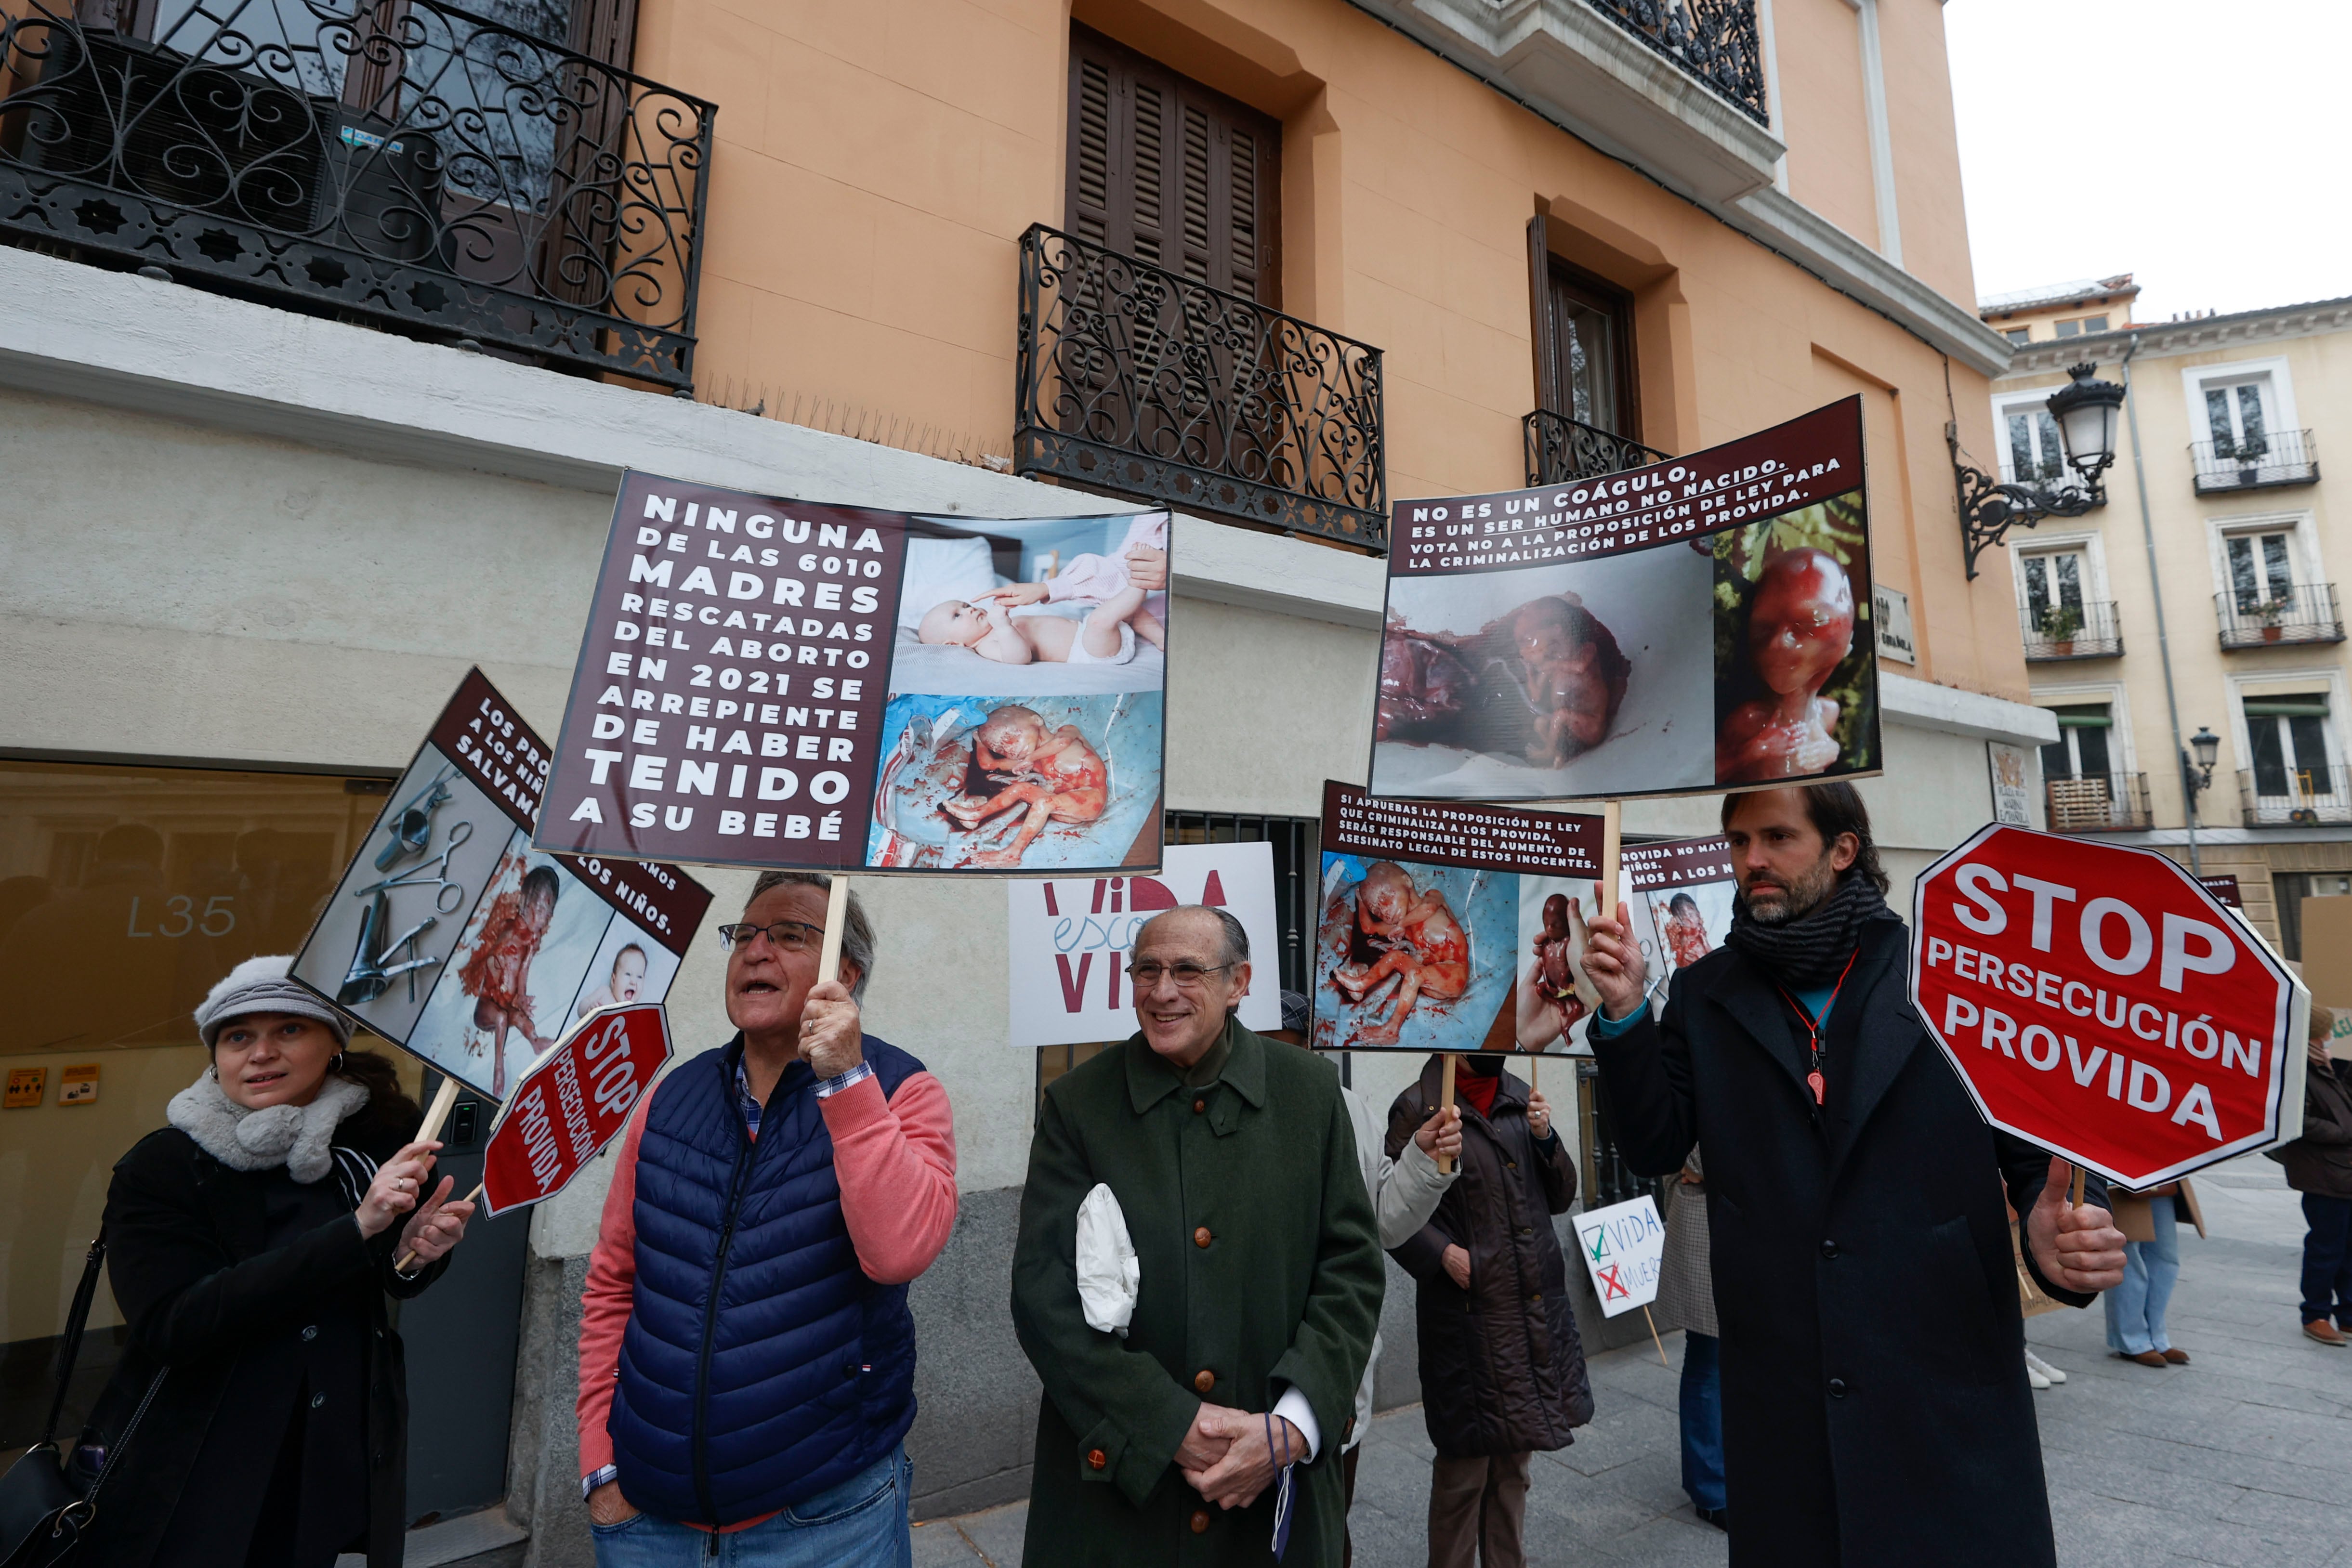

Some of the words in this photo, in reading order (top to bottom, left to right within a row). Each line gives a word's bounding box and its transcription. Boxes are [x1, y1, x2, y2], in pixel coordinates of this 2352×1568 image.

[1411, 543, 1459, 554] VOTA
[1468, 540, 1492, 551] NO
[1501, 538, 1513, 548] A
[1522, 534, 1545, 546] LA
[1554, 504, 1690, 541] PROPOSICIÓN
[1700, 494, 1726, 511] DE
[1736, 480, 1773, 501] LEY
[1783, 458, 1840, 486] PARA
[1412, 526, 1435, 538] ES
[1446, 524, 1473, 536] UN
[1485, 519, 1523, 533] SER
[1535, 499, 1629, 527] HUMANO
[1641, 490, 1672, 507] NO
[1683, 459, 1785, 497] NACIDO.
[1413, 507, 1448, 522] NO
[1462, 503, 1491, 519] ES
[1505, 497, 1539, 514] UN
[1553, 466, 1696, 508] COÁGULO,
[643, 494, 884, 552] NINGUNA
[1409, 558, 1431, 568] LA
[1440, 537, 1614, 567] CRIMINALIZACIÓN
[1624, 530, 1648, 545] DE
[1658, 519, 1695, 537] LOS
[1705, 489, 1809, 526] PROVIDA.
[636, 526, 688, 553] DE
[708, 540, 779, 566] LAS
[798, 553, 881, 578] 6010
[628, 554, 879, 613] MADRES
[620, 593, 873, 641] RESCATADAS
[614, 621, 690, 651] DEL
[709, 637, 869, 669] ABORTO
[606, 652, 667, 681] EN
[689, 665, 789, 695] 2021
[812, 677, 862, 701] SE
[479, 697, 515, 738] LOS
[597, 685, 858, 730] ARREPIENTE
[469, 718, 482, 734] A
[484, 731, 514, 765] LOS
[515, 763, 543, 795] NIÑ
[592, 713, 660, 746] DE
[685, 725, 854, 762] HABER
[584, 749, 850, 805] TENIDO
[569, 797, 603, 823] A
[630, 802, 694, 831] SU
[718, 810, 842, 841] BEBÉ
[1339, 820, 1375, 833] SERÁS
[1380, 826, 1466, 845] RESPONSABLE
[1471, 838, 1494, 848] DEL
[1499, 841, 1562, 854] AUMENTO
[1568, 847, 1585, 856] DE
[1340, 794, 1352, 804] SI
[1356, 797, 1418, 815] APRUEBAS
[1422, 808, 1437, 818] LA
[1443, 810, 1529, 828] PROPOSICIÓN
[1536, 820, 1551, 830] DE
[1558, 823, 1581, 833] LEY
[1340, 807, 1363, 819] QUE
[1367, 812, 1445, 831] CRIMINALIZA
[1450, 824, 1458, 833] A
[1463, 825, 1486, 835] LOS
[1492, 828, 1555, 844] PROVIDA,
[1338, 833, 1403, 850] ASESINATO
[1408, 843, 1445, 855] LEGAL
[1451, 848, 1467, 857] DE
[1472, 850, 1511, 862] ESTOS
[1517, 854, 1597, 869] INOCENTES.
[1621, 849, 1672, 862] ROVIDA
[1677, 847, 1694, 855] NO
[1698, 842, 1730, 853] MATA
[1672, 871, 1682, 880] A
[1687, 866, 1716, 878] LOS
[128, 895, 236, 937] L35
[615, 880, 671, 935] NIÑOS.
[1952, 863, 2235, 993] STOP
[1928, 936, 2262, 1078] PERSECUCIÓN
[585, 1016, 638, 1118] STOP
[1944, 993, 2223, 1142] PROVIDA
[553, 1047, 596, 1164] PERSECUCIÓN
[515, 1085, 562, 1194] PROVIDA
